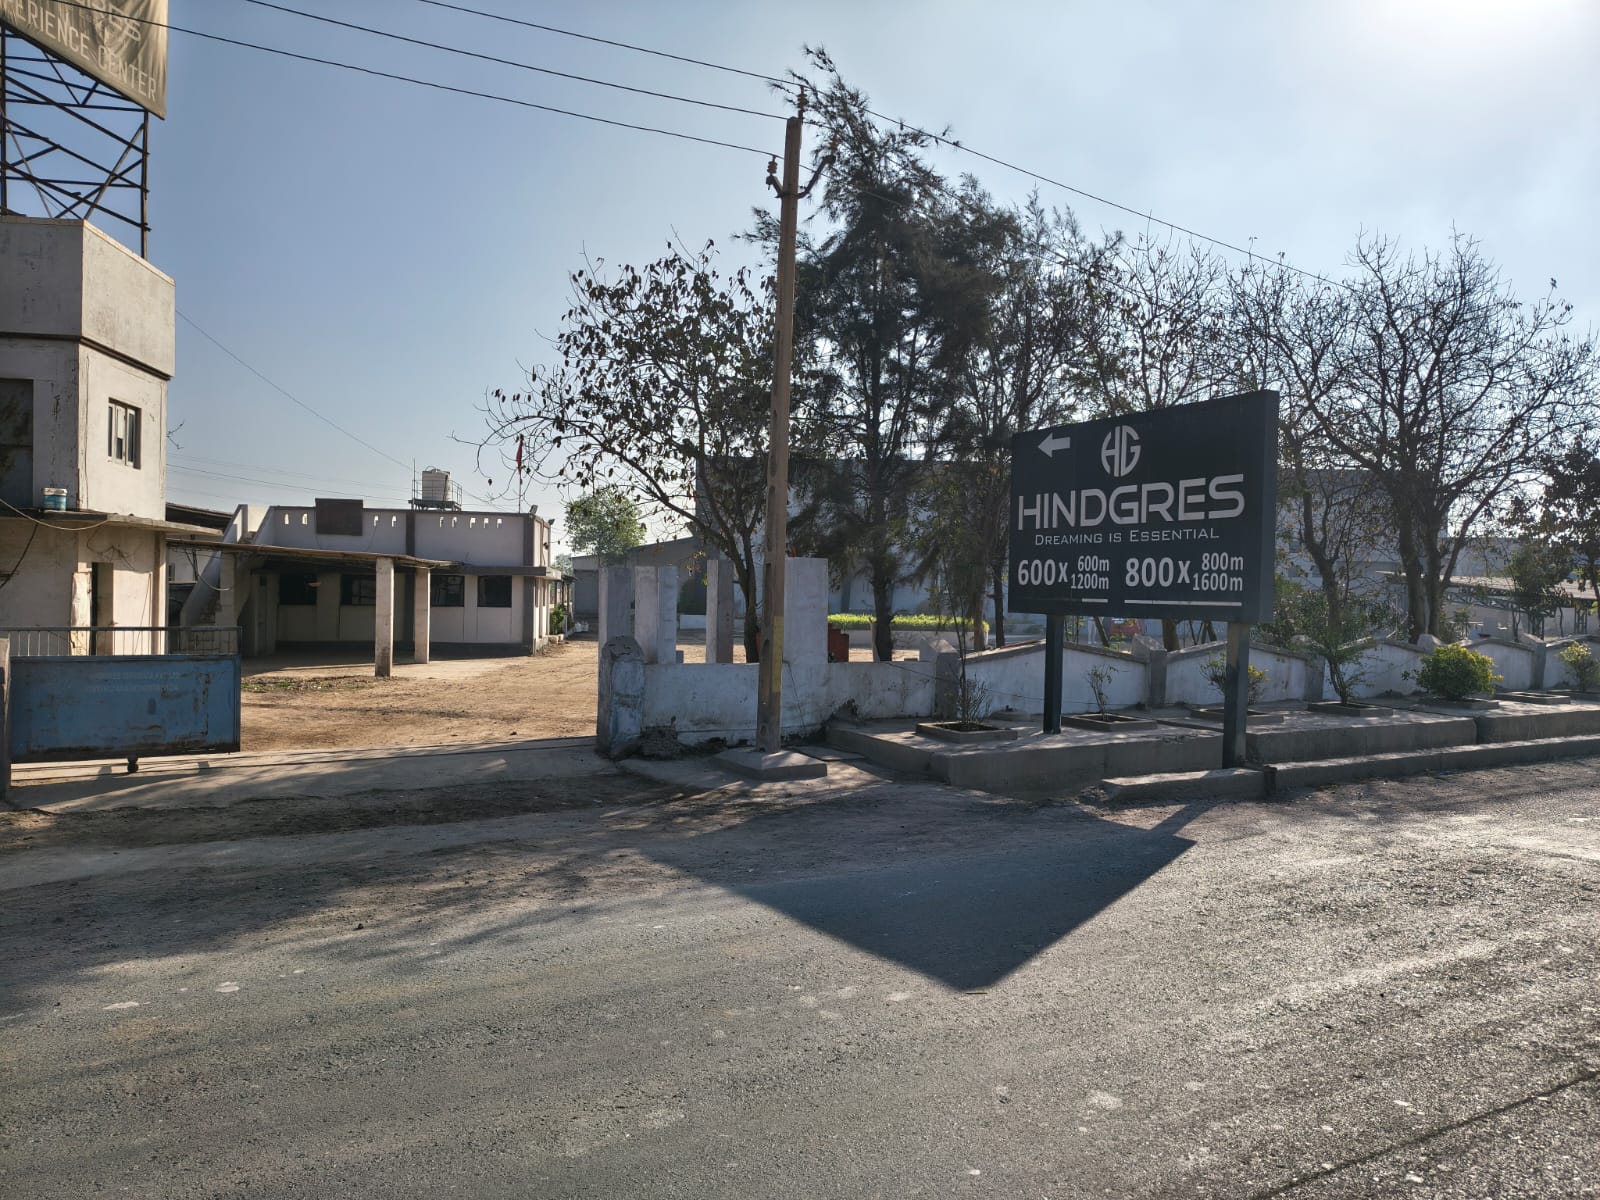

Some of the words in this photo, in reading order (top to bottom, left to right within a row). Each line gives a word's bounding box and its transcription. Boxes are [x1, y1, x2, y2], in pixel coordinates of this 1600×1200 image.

[99, 45, 157, 102] CENTER
[1101, 425, 1141, 477] HG
[1018, 473, 1245, 530] HINDGRES
[1130, 528, 1220, 542] ESSENTIAL
